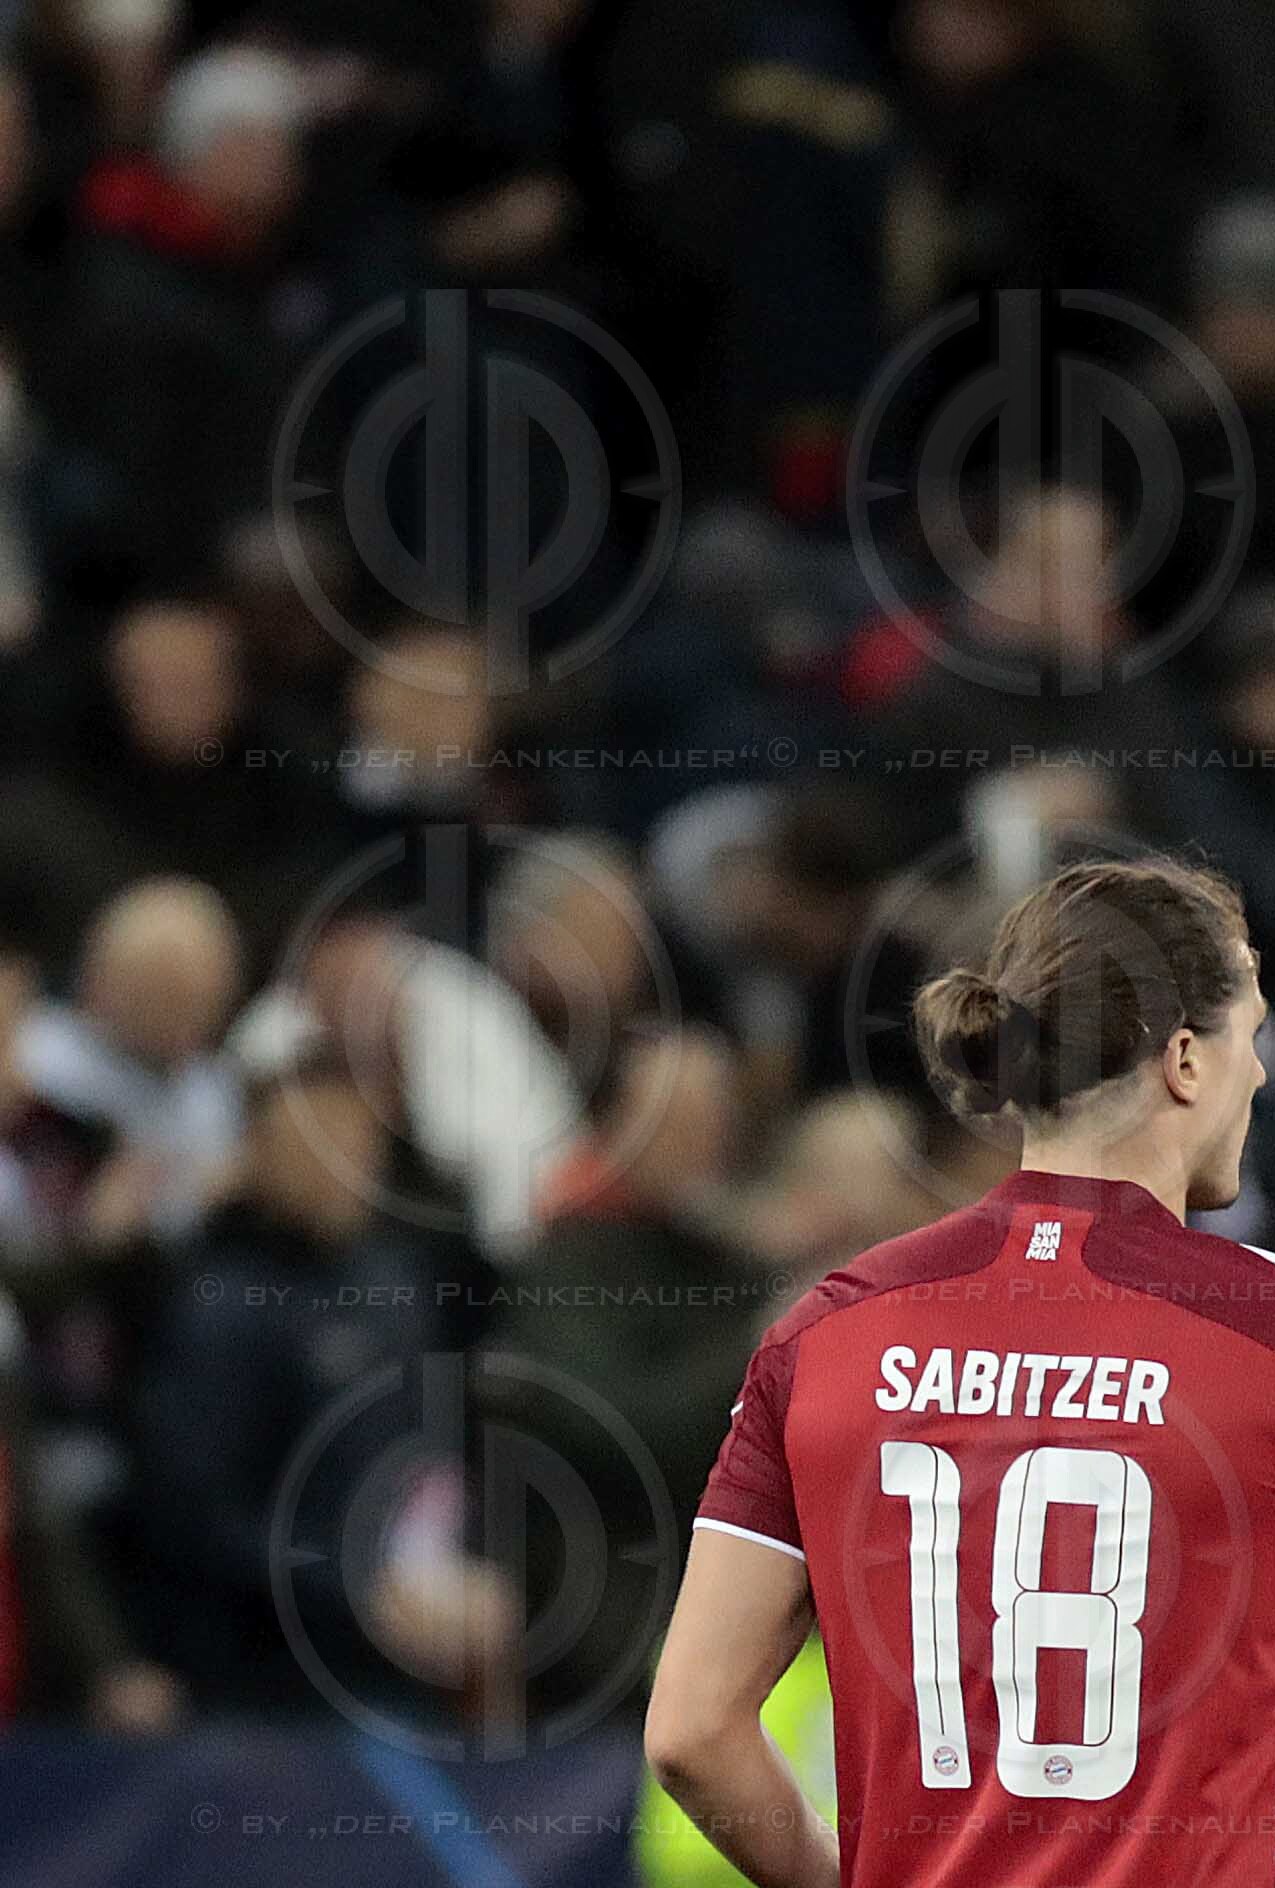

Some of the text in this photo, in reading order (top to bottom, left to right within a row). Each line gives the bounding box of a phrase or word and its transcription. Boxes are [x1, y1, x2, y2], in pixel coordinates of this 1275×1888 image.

[1030, 1234, 1060, 1249] SAN
[875, 1346, 1171, 1426] SABITZER
[880, 1441, 1153, 1801] 18
